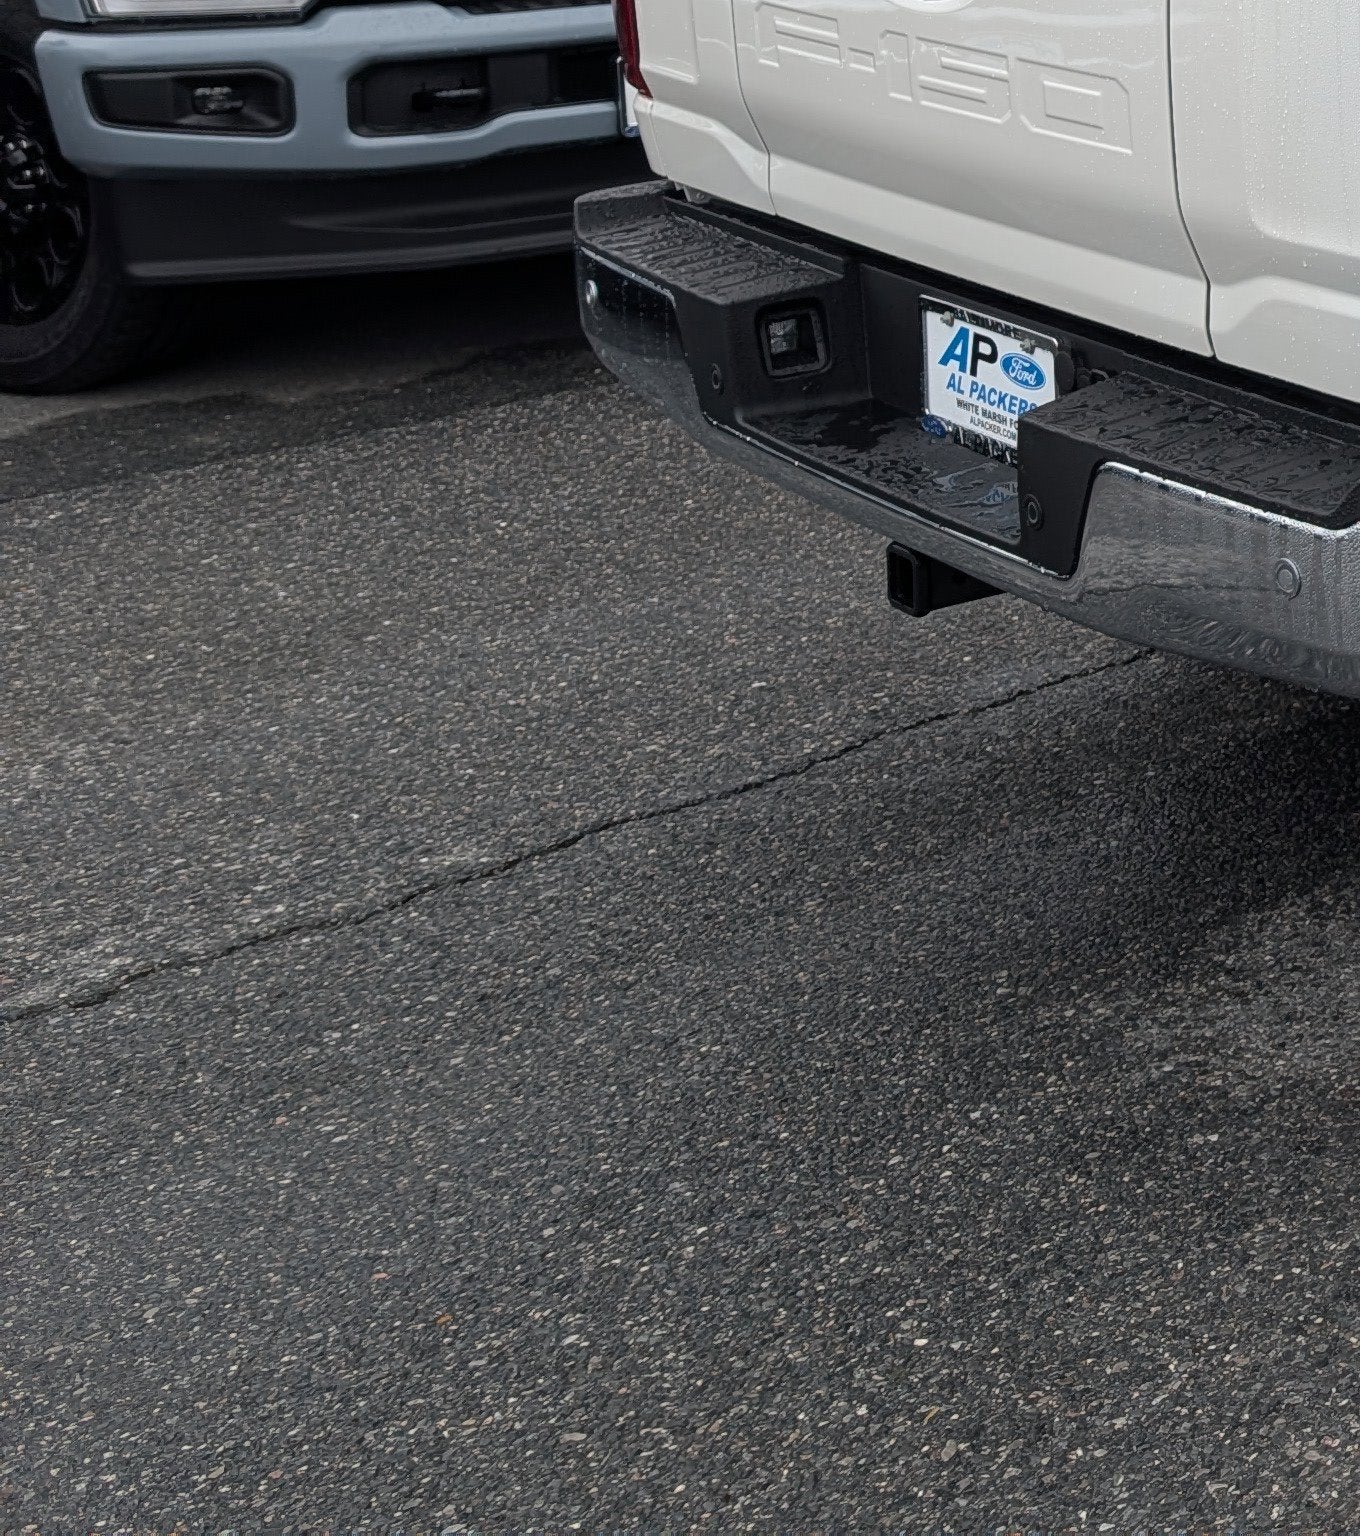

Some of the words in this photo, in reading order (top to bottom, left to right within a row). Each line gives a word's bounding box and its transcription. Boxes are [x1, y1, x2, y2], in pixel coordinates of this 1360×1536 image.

[754, 0, 1134, 155] F-150
[938, 326, 999, 378] AP
[946, 373, 965, 395] AL
[956, 397, 980, 416] WHITE
[981, 408, 1007, 428] MARSH
[970, 416, 1018, 441] ALPACKER.COM
